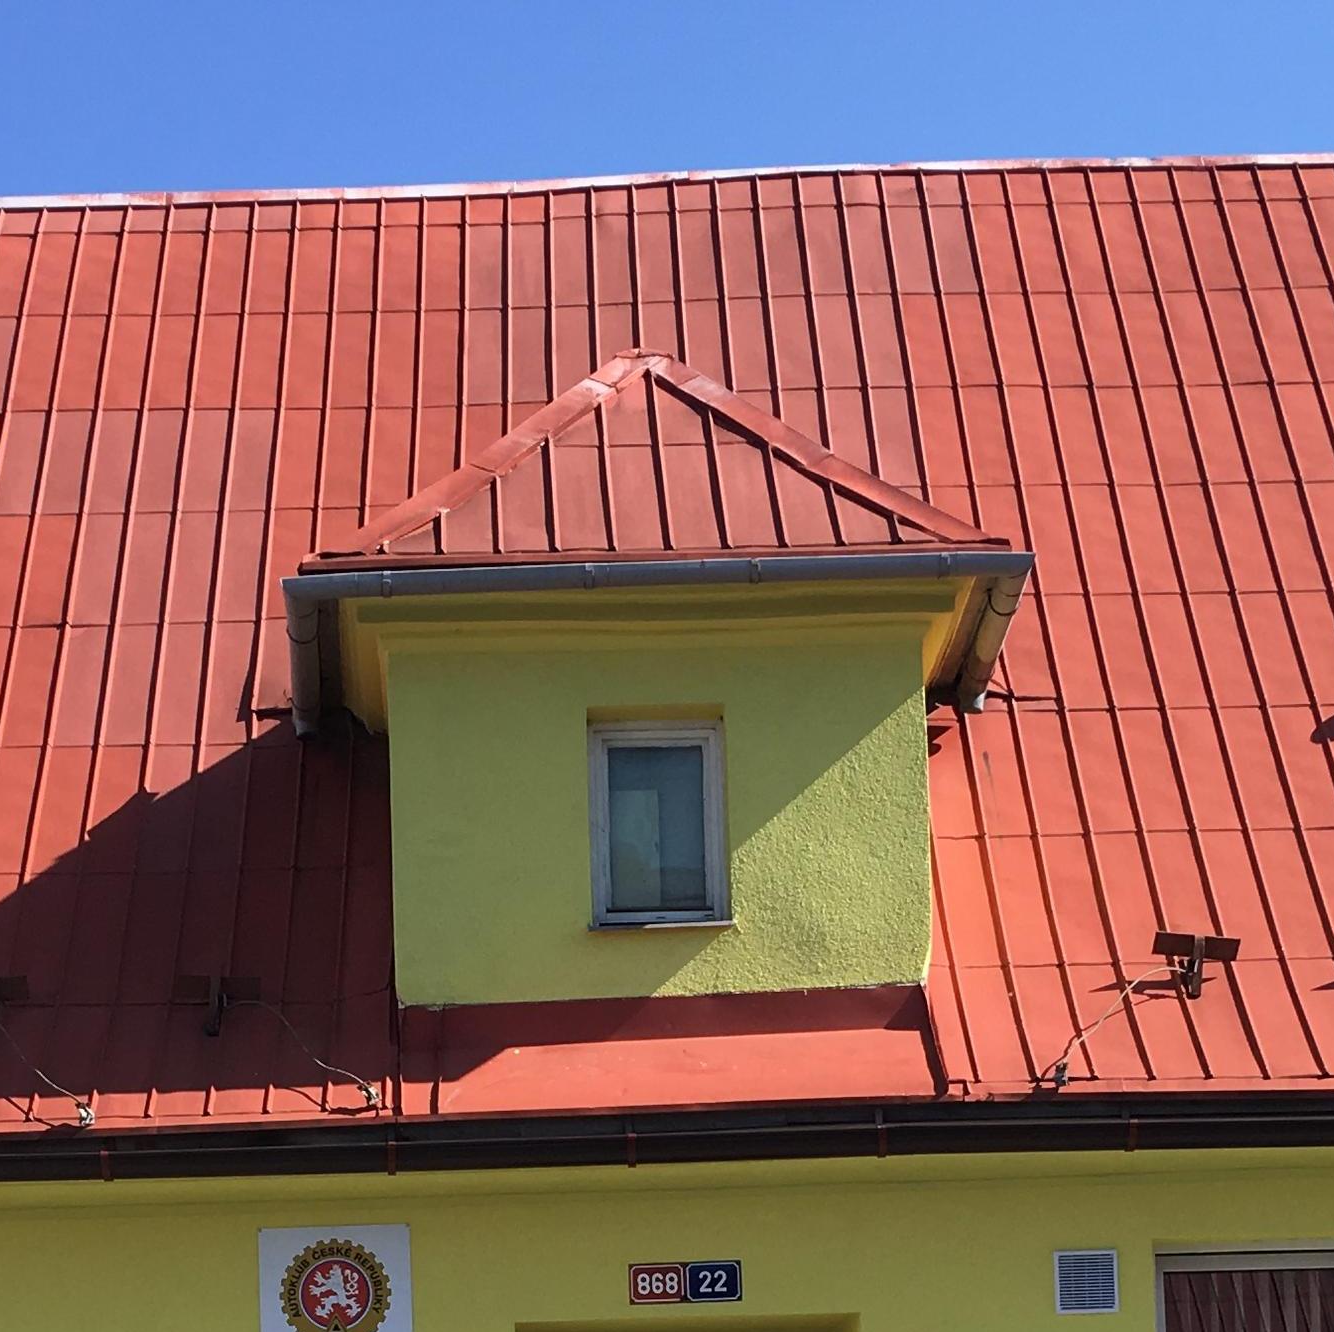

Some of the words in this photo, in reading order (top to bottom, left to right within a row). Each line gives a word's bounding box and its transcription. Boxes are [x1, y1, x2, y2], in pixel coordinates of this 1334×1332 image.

[287, 1258, 310, 1318] AUTOKLUB
[311, 1246, 353, 1260] ČESKÉ
[354, 1253, 383, 1314] REPUBLIKY
[637, 1272, 679, 1295] 868
[698, 1270, 728, 1293] 22
